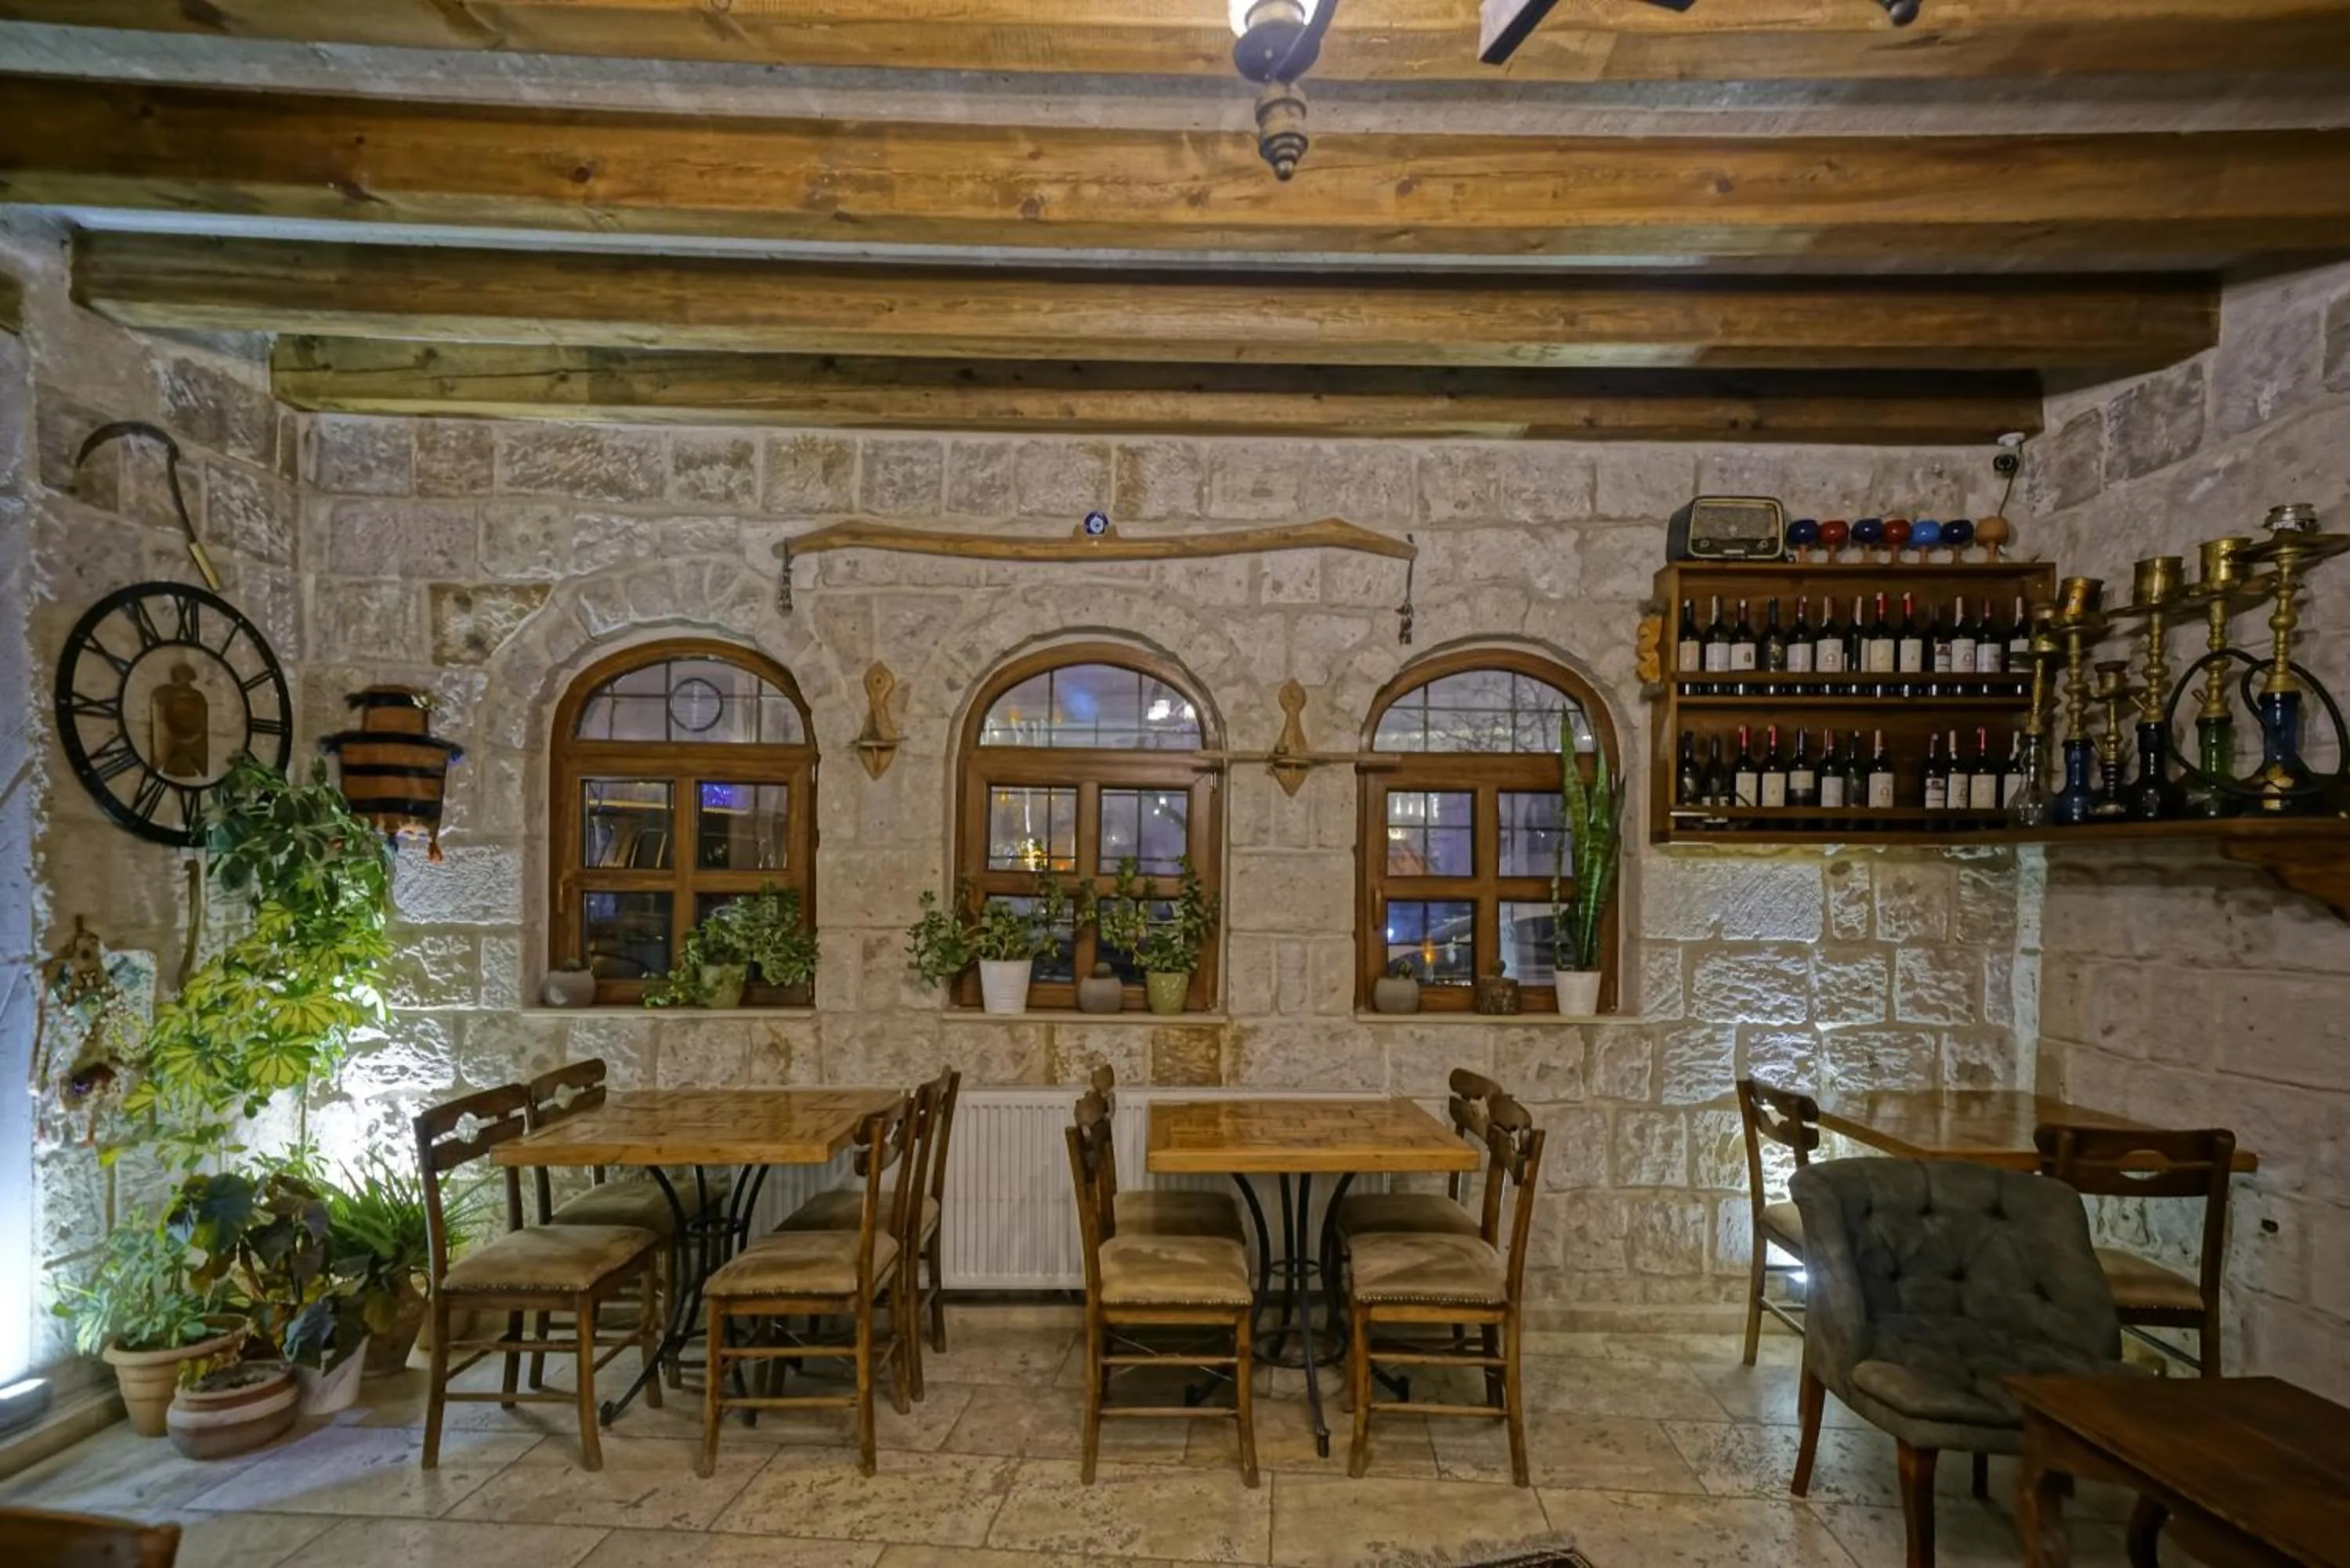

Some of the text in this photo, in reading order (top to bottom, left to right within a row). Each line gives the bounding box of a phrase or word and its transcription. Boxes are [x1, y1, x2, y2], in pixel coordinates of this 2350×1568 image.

[173, 594, 200, 645] XII
[80, 635, 132, 674] X
[250, 718, 284, 735] III
[133, 771, 168, 823] VII
